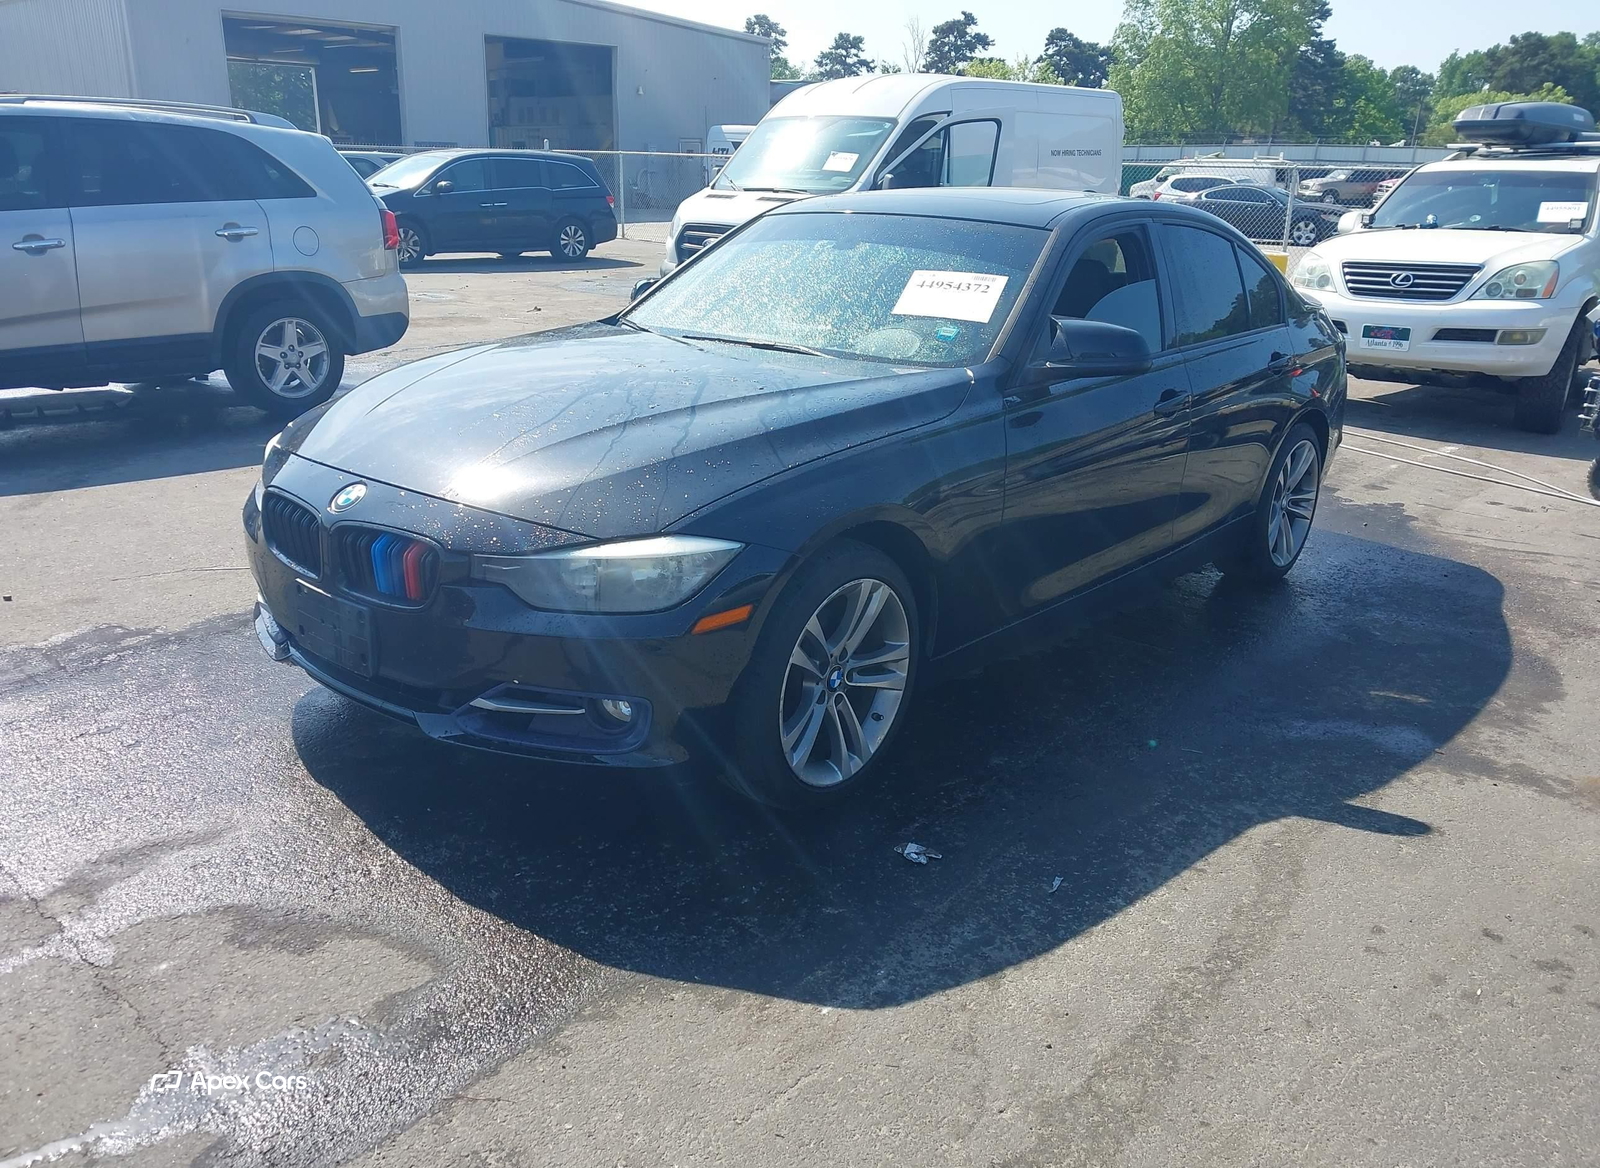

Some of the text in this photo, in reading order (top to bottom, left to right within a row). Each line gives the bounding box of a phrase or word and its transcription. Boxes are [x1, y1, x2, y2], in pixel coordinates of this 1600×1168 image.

[916, 280, 990, 293] 44954372
[1366, 339, 1404, 348] Atlanta 1996
